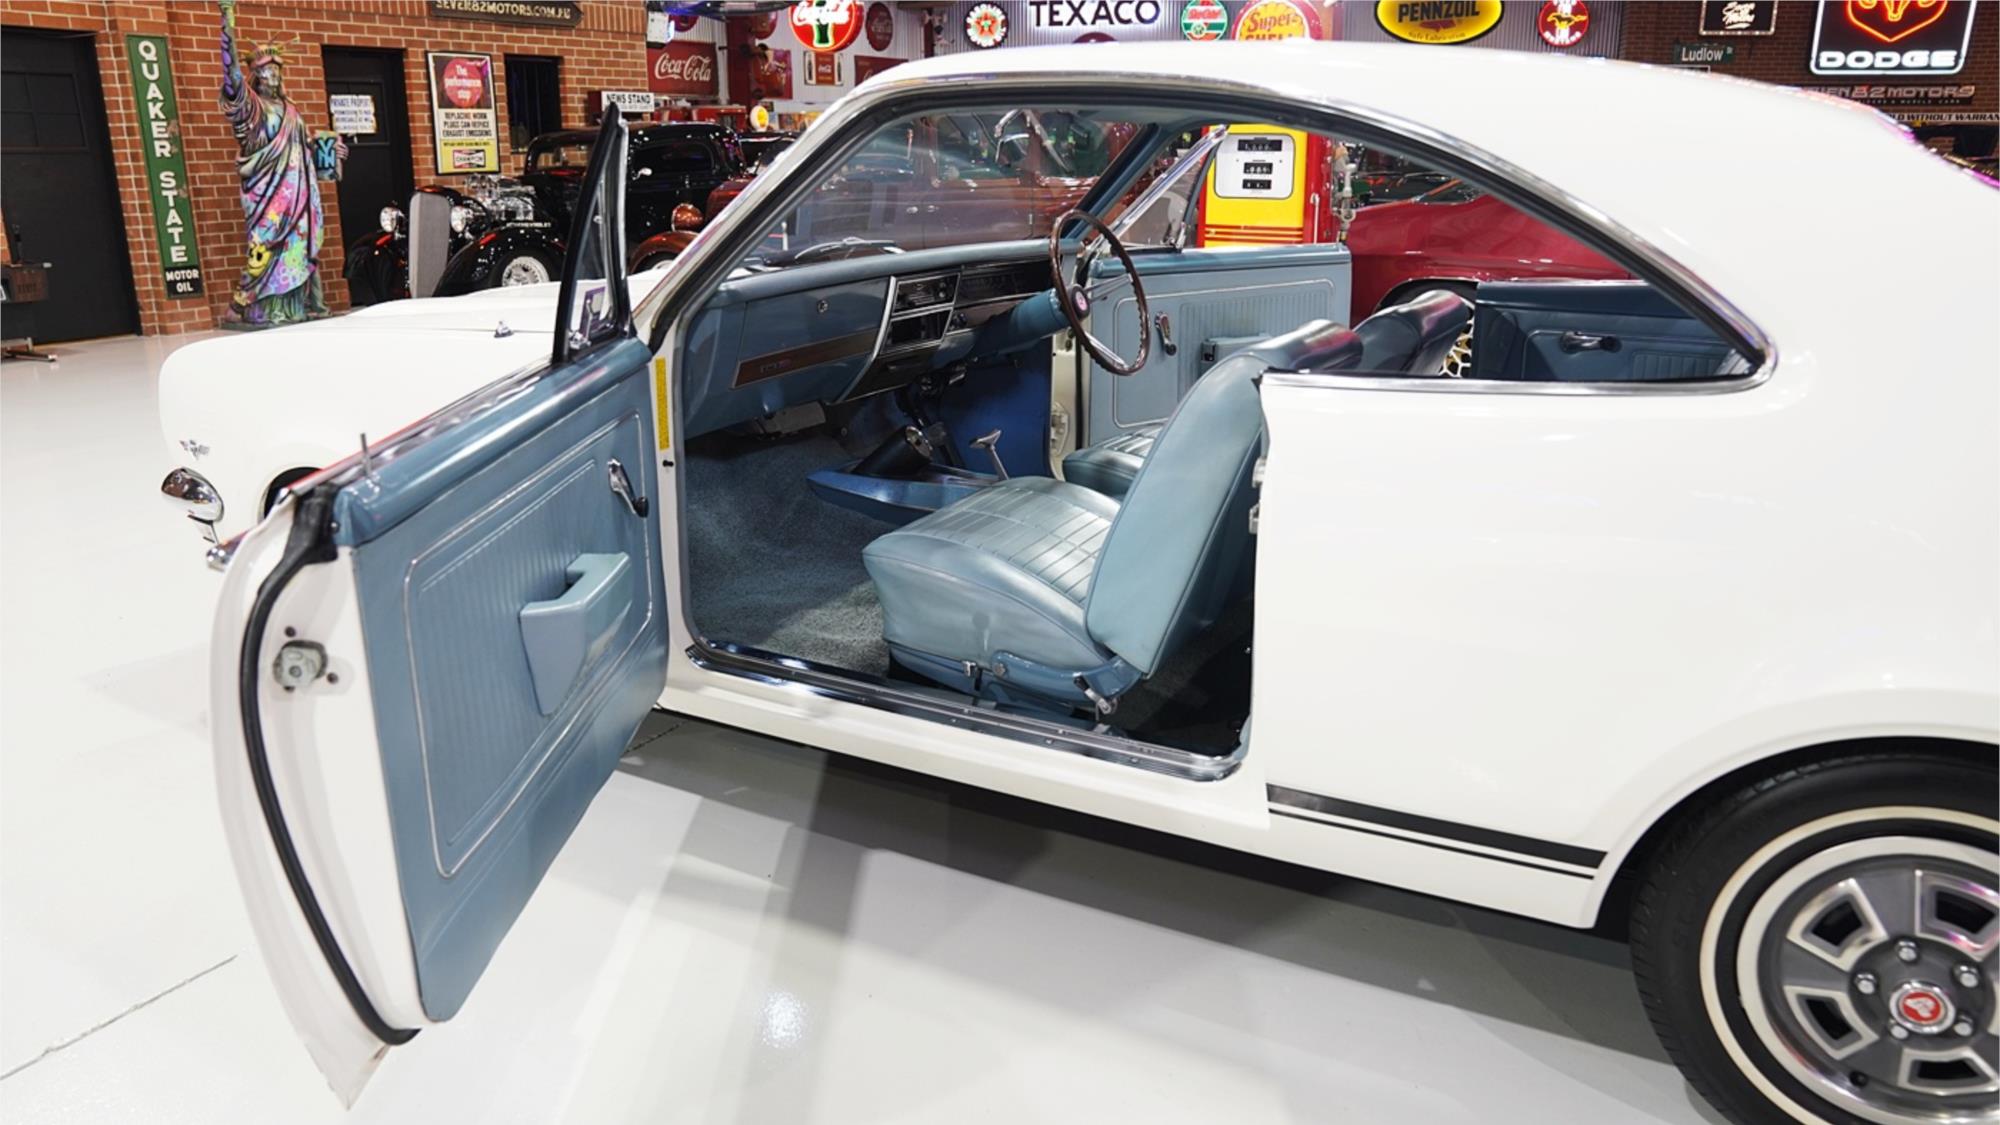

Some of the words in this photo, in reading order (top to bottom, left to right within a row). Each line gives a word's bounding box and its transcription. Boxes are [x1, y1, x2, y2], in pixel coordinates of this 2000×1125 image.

[1029, 0, 1161, 27] TEXACO
[1398, 1, 1481, 23] PENNZOIL
[1681, 46, 1724, 61] Ludlow
[1818, 50, 1958, 68] DODGE
[654, 52, 712, 82] Coca-Cola
[138, 40, 172, 158] QUAKER
[628, 94, 651, 105] STAND
[159, 171, 188, 263] STATE
[165, 269, 199, 281] MOTOR
[176, 282, 194, 292] OIL
